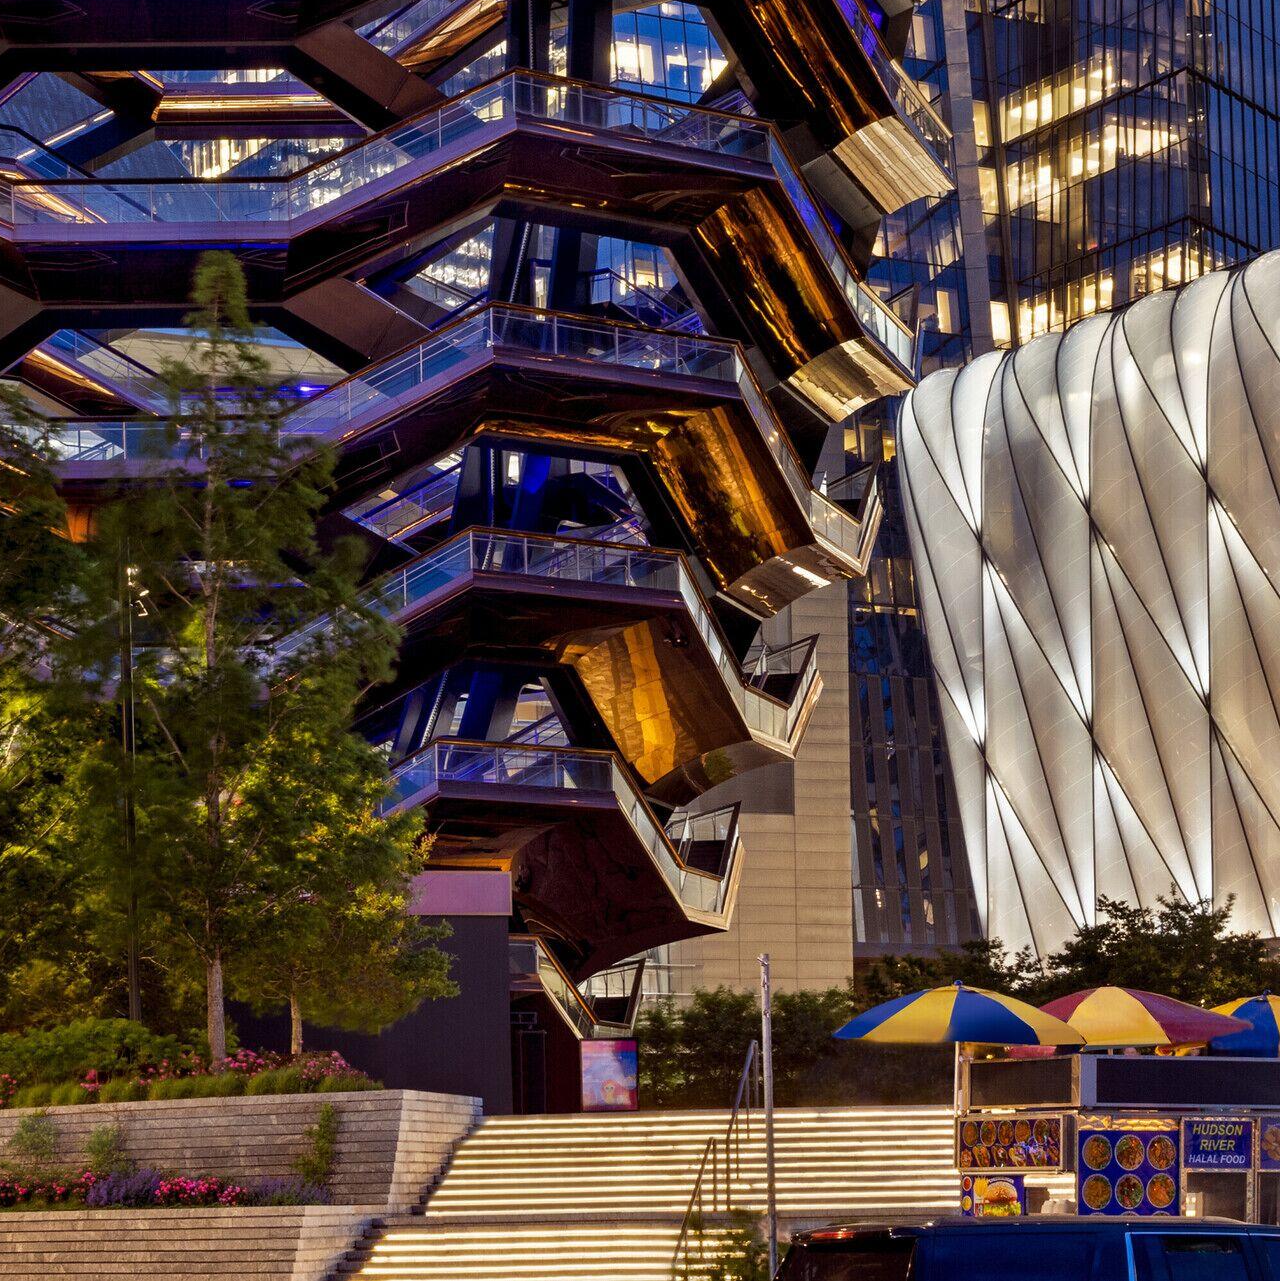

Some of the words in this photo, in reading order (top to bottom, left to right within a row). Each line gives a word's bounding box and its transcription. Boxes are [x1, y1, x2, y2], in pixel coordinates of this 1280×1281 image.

[1192, 1124, 1244, 1136] HUDSON
[1200, 1139, 1236, 1151] RIVER
[1188, 1154, 1218, 1163] HALAL
[1220, 1155, 1246, 1164] FOOD
